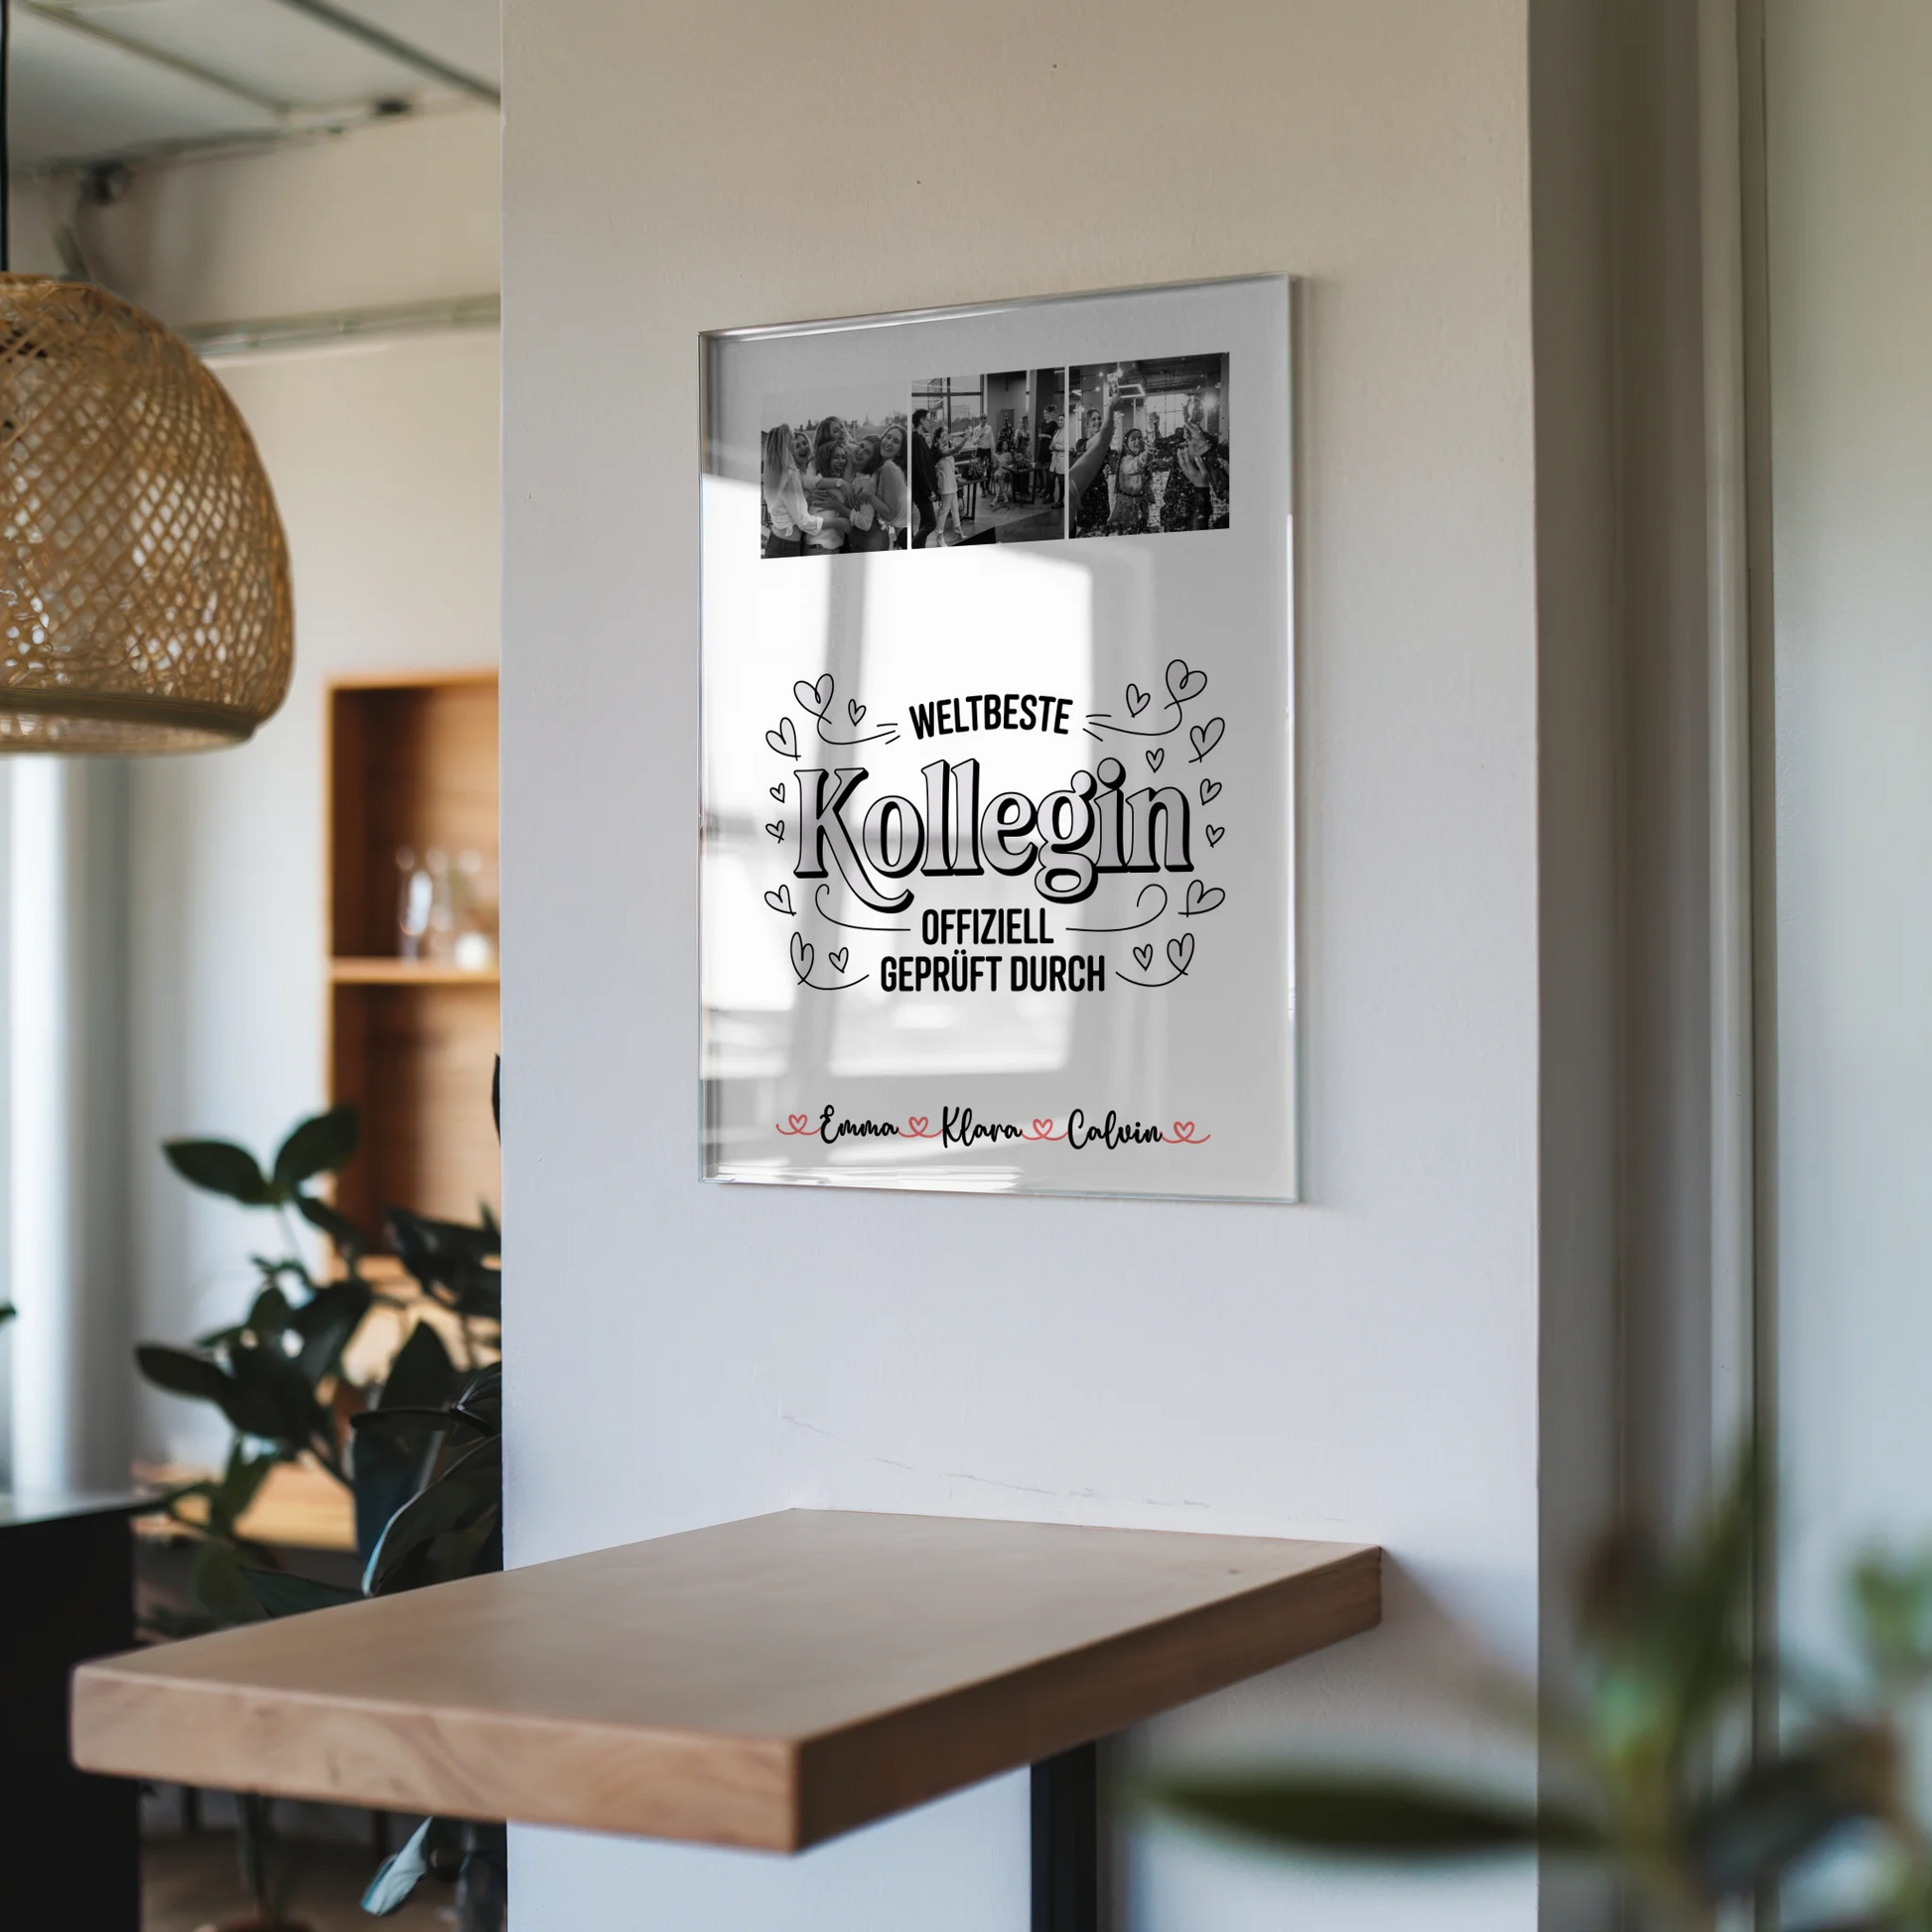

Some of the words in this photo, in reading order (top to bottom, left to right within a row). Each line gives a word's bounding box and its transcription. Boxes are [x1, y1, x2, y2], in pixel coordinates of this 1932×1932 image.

[909, 694, 1073, 741] WELTBESTE
[793, 758, 1194, 913] Kollegin
[921, 907, 1054, 945] OFFIZIELL
[881, 949, 1003, 992] GEPRÜFT
[1010, 955, 1105, 992] DURCH
[819, 1104, 899, 1144] Emma
[942, 1105, 1024, 1149] Klara
[1067, 1108, 1164, 1150] Calvin
